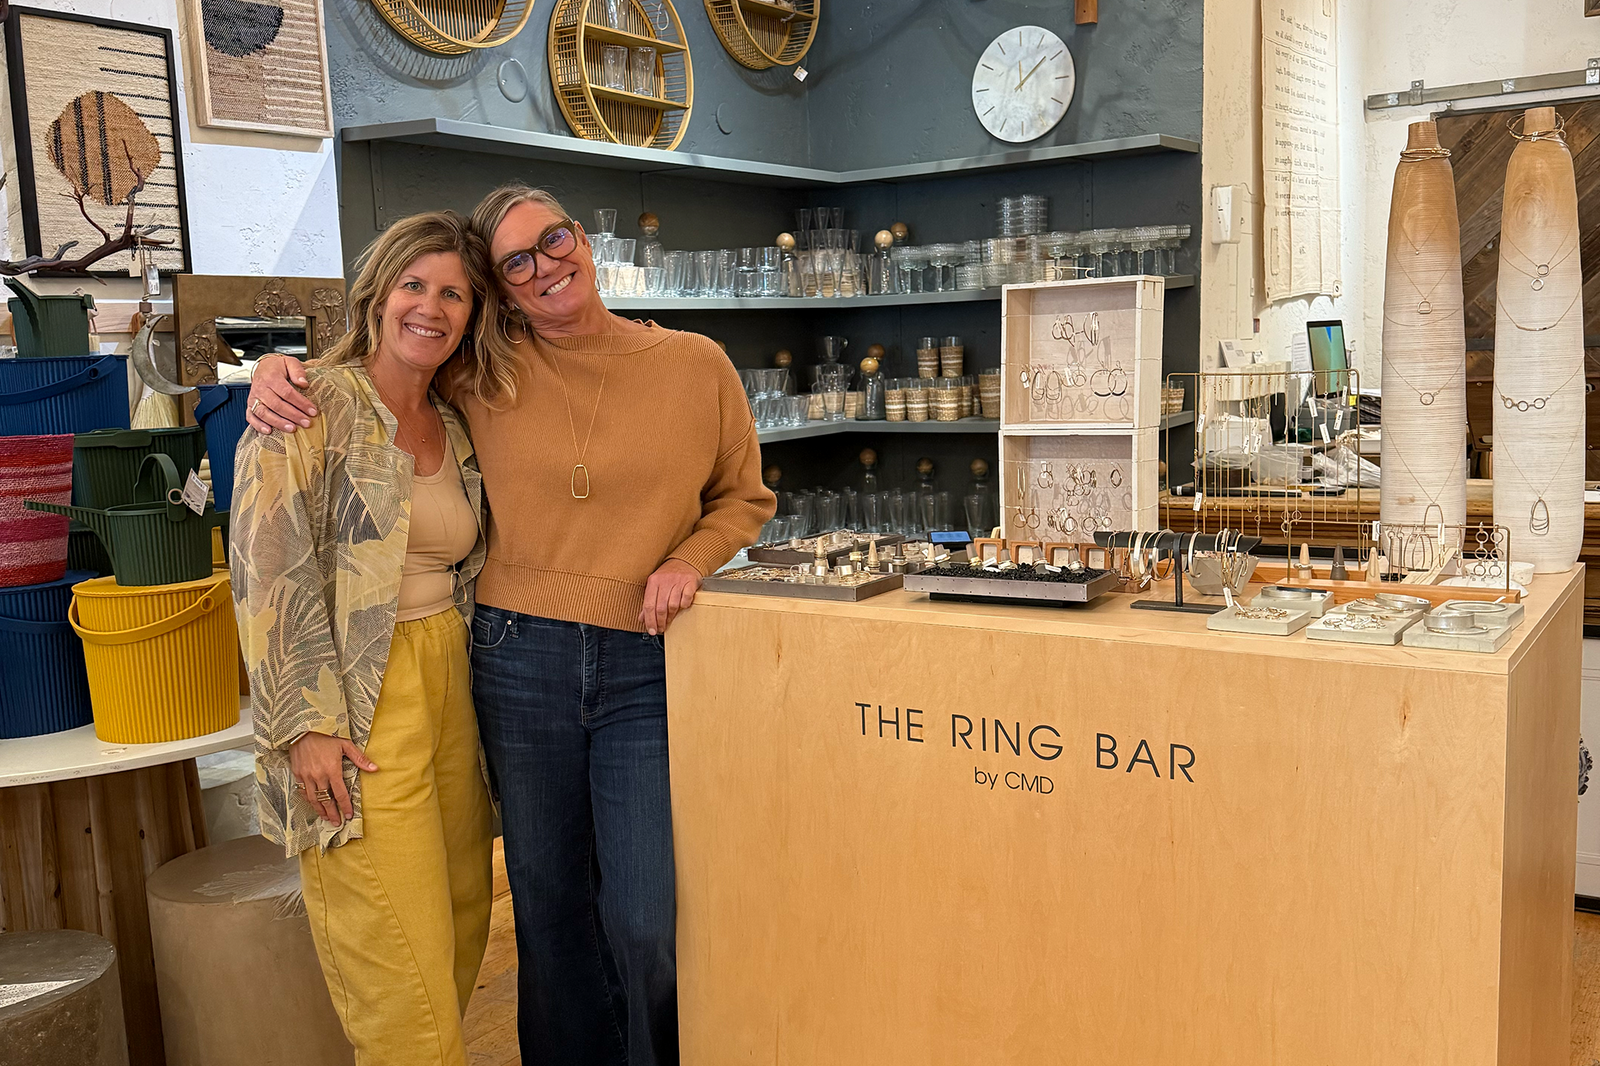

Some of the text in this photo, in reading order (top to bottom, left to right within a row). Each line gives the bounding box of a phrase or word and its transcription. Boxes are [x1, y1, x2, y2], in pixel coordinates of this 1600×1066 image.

[854, 701, 1196, 783] THE RING BAR
[974, 766, 1055, 795] by CMD
